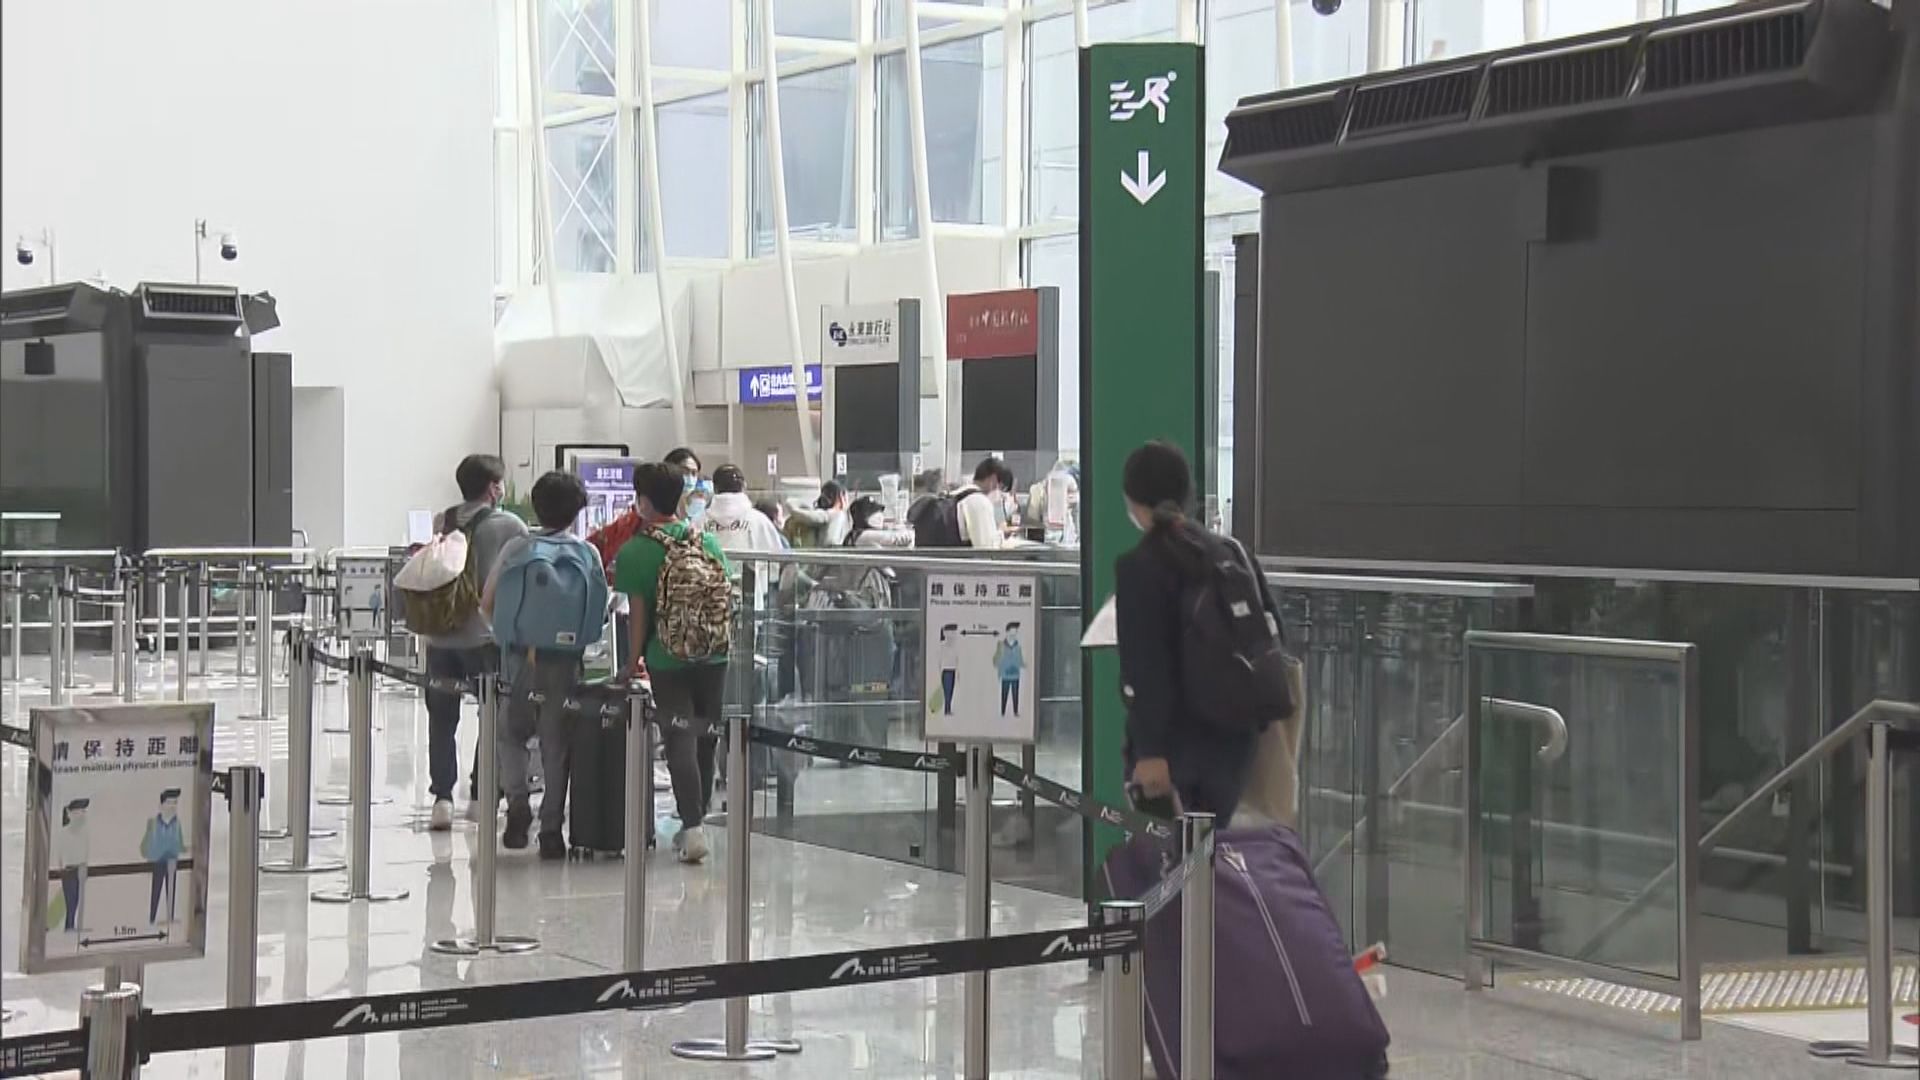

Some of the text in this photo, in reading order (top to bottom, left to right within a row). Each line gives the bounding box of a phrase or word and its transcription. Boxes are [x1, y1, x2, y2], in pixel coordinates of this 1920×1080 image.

[931, 582, 1032, 597] 請保持距離
[53, 765, 80, 775] lease
[81, 762, 122, 773] maintain
[122, 760, 159, 773] physical
[113, 926, 136, 936] 1.5m
